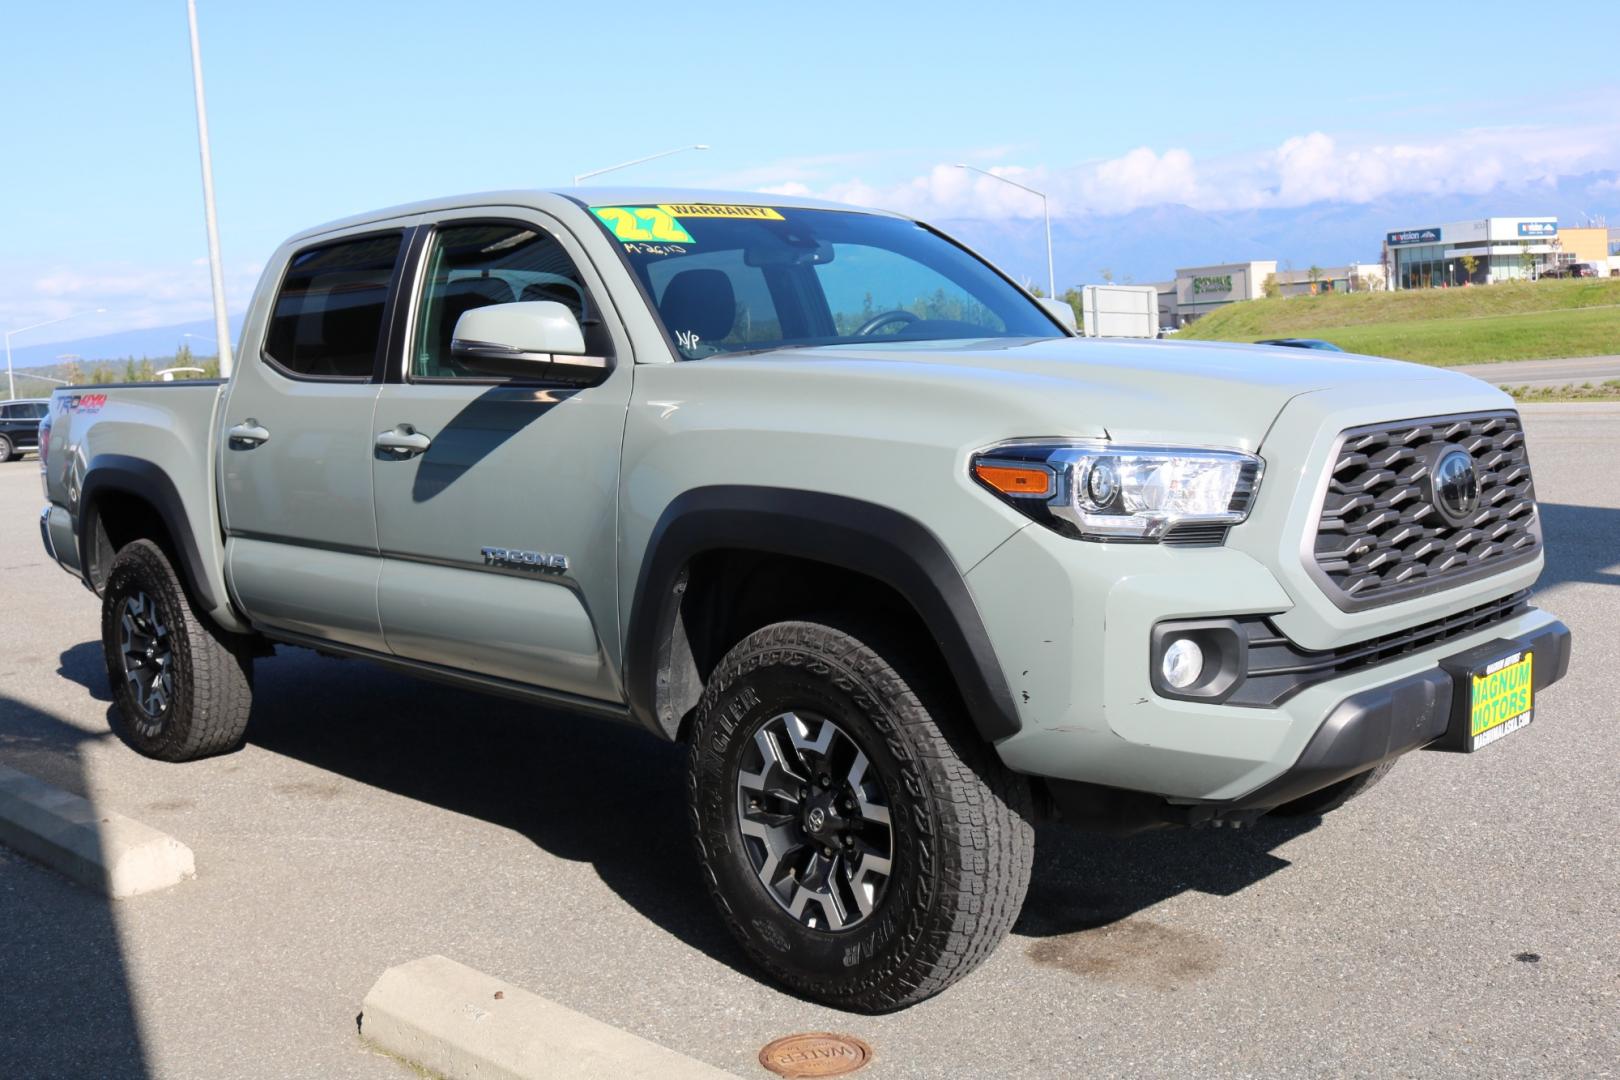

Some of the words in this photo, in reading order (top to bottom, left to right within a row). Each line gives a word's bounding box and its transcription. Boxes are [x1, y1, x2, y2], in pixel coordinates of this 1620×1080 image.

[596, 207, 689, 242] 22
[669, 205, 769, 217] WARRANTY
[57, 395, 81, 413] TRD
[481, 545, 569, 575] TACOMA
[1472, 662, 1530, 707] MAGNUM
[1473, 688, 1527, 732] MOTORS
[781, 1046, 852, 1064] WATER
